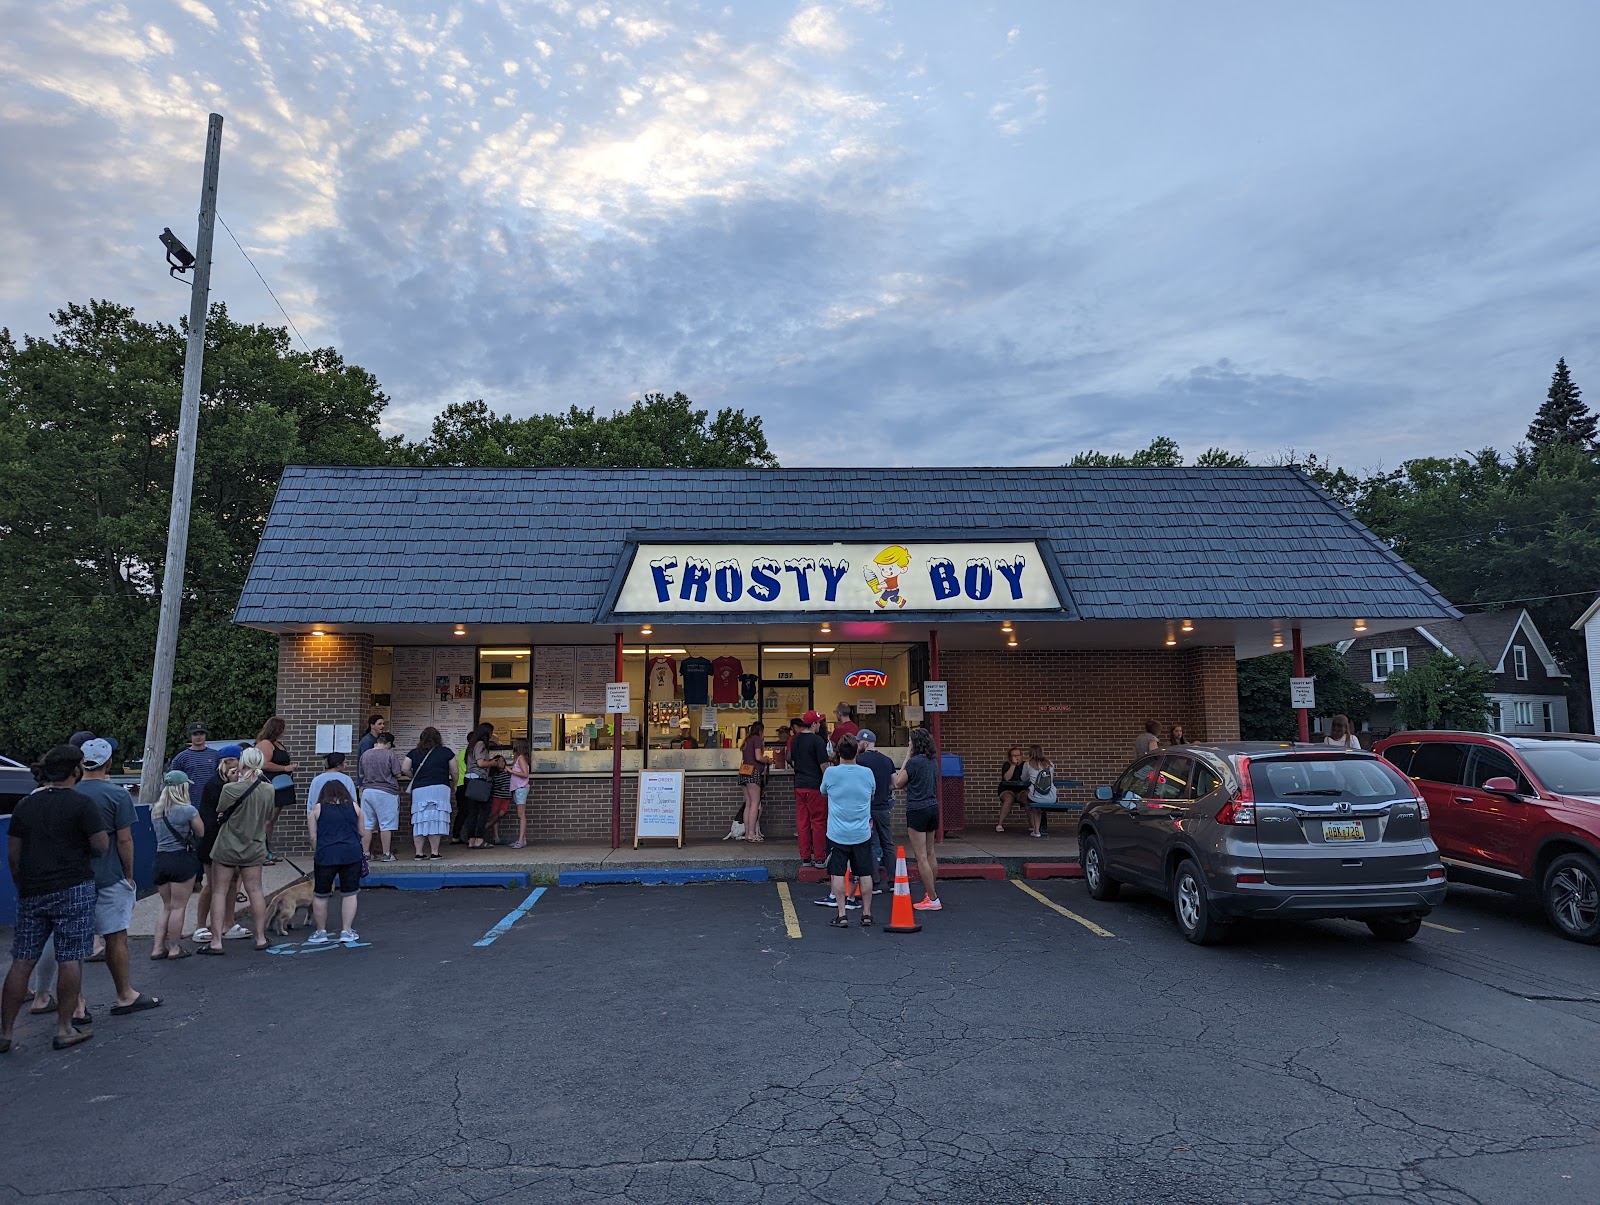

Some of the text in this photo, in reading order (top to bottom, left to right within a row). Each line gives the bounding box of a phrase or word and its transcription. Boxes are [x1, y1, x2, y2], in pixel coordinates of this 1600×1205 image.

[649, 554, 1026, 603] FROSTY BOY
[847, 674, 888, 687] OPEN
